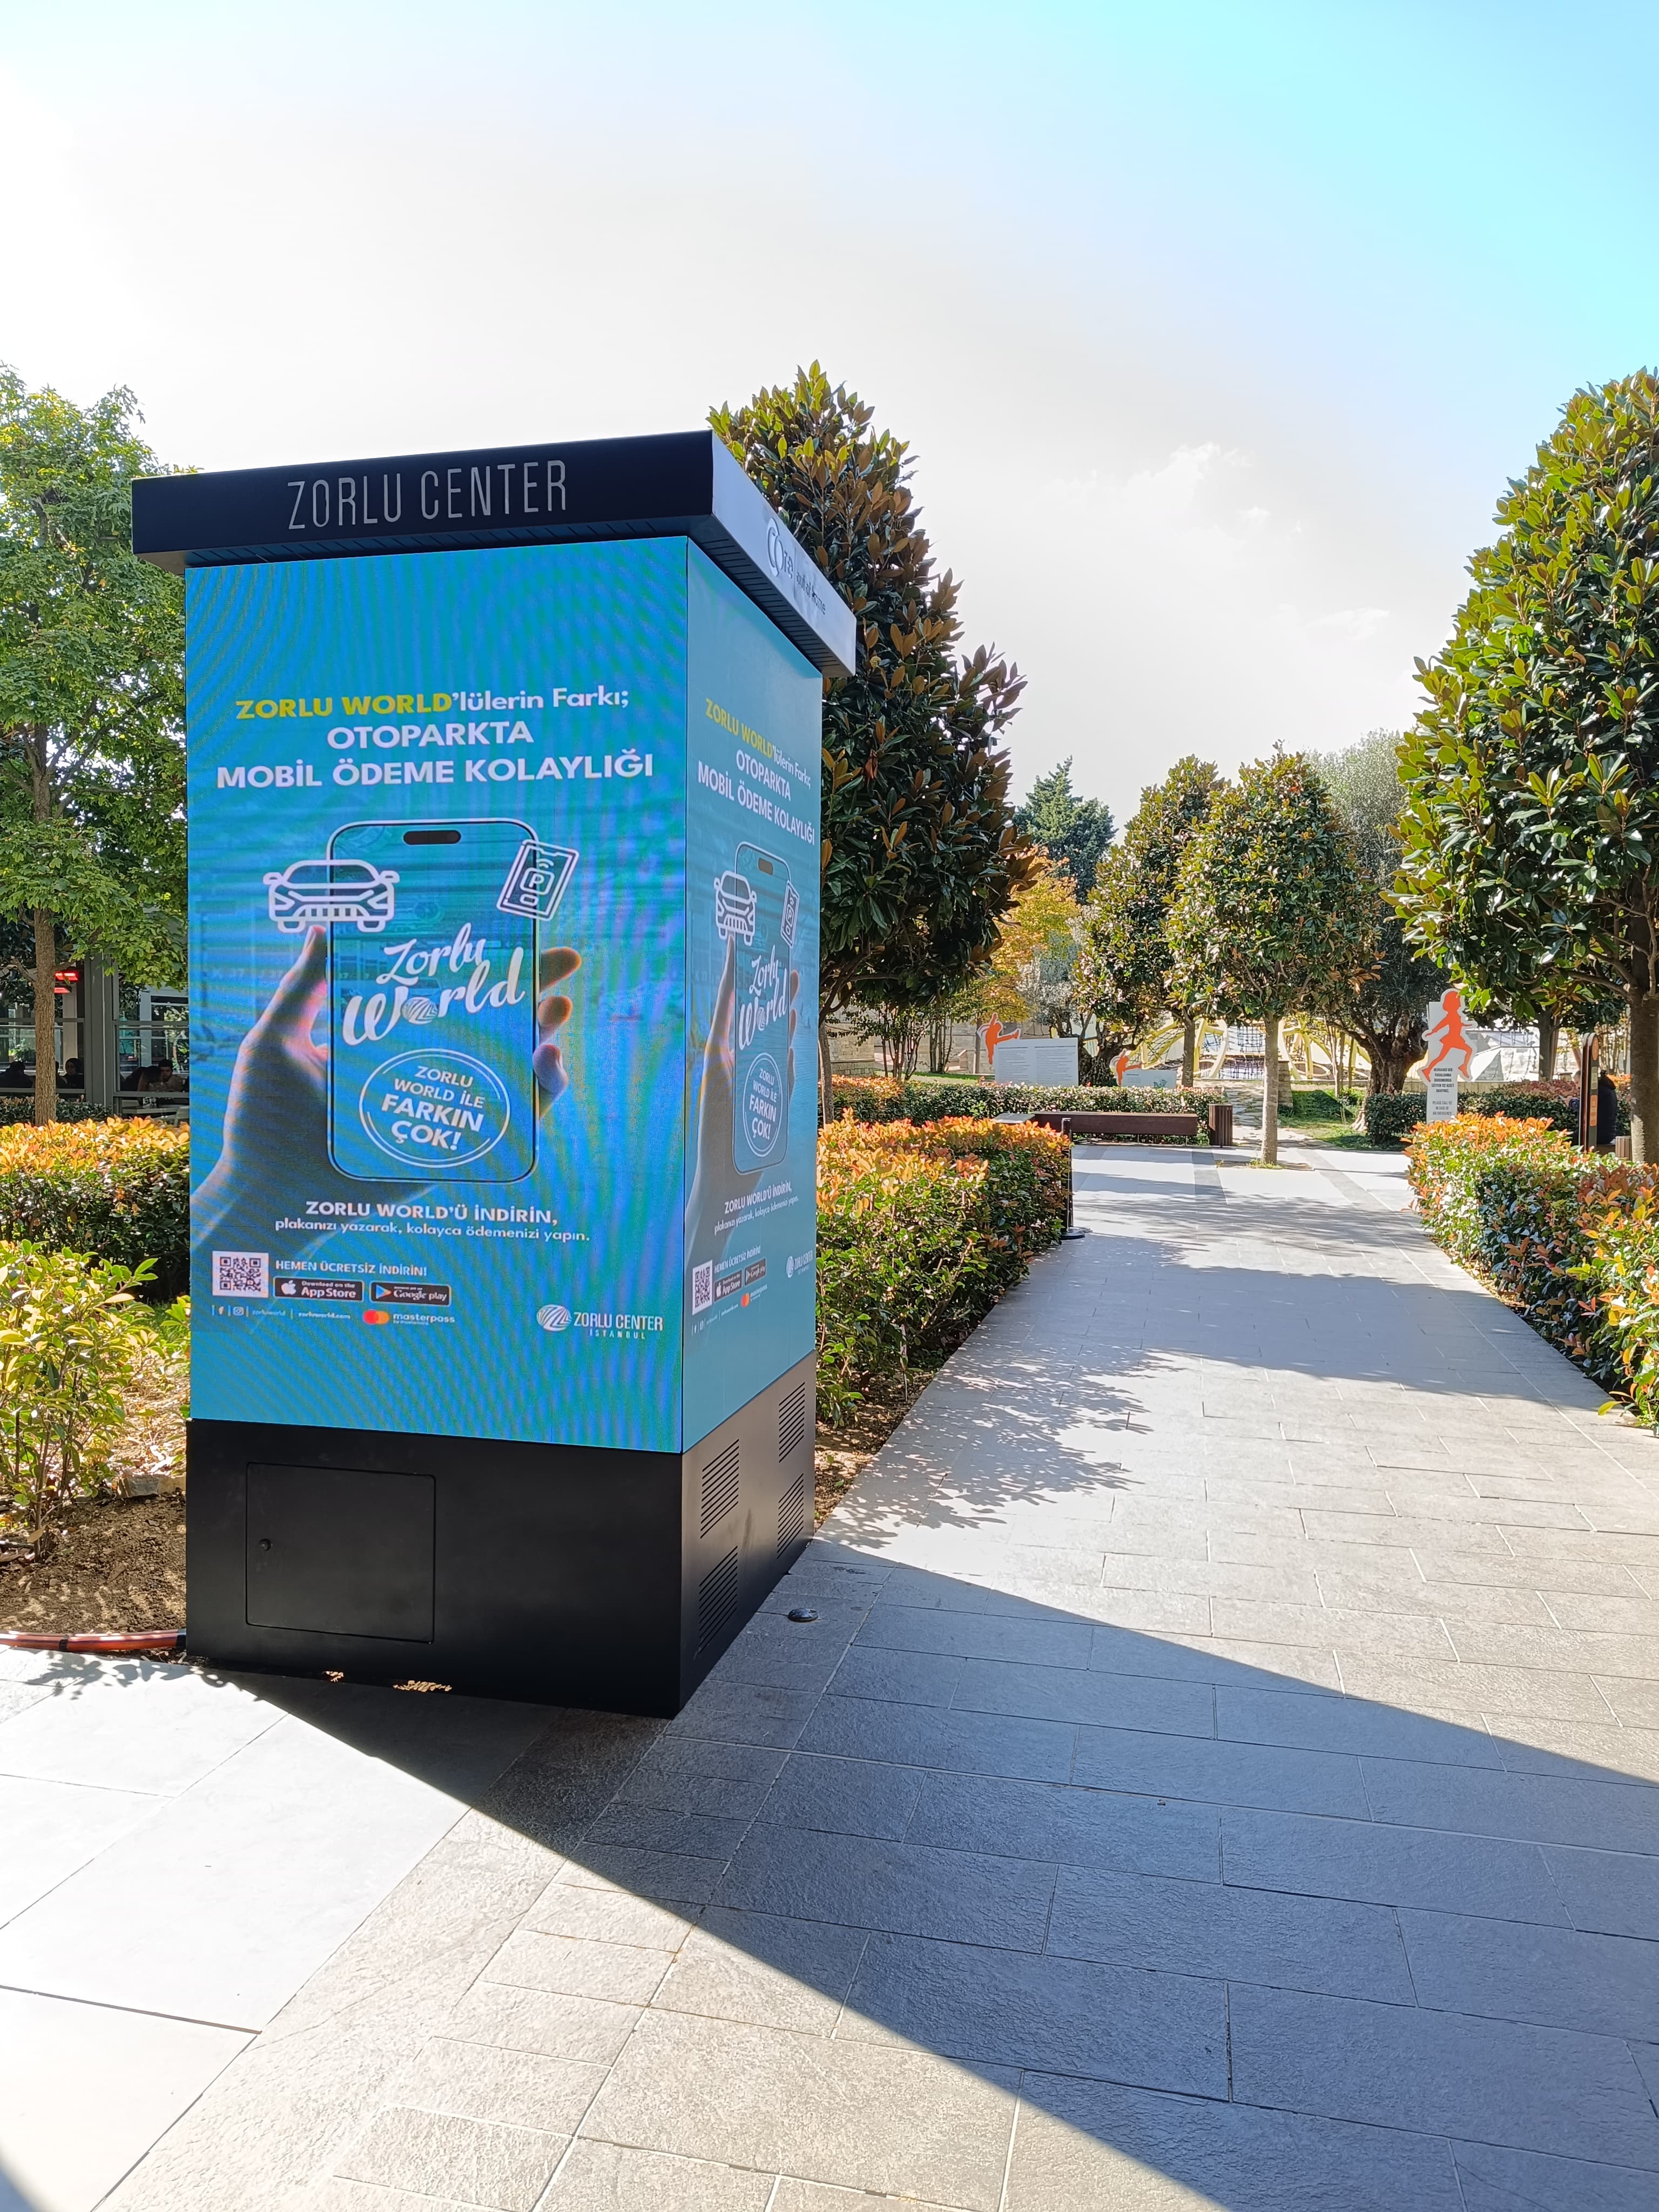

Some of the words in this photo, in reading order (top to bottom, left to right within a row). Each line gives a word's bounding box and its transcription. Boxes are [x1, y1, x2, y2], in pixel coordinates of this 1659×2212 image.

[287, 473, 401, 530] ZORLU
[420, 460, 567, 520] CENTER
[236, 697, 333, 719] ZORLU
[341, 690, 544, 716] WORLD'lülerin
[553, 685, 629, 708] Farkı;
[705, 697, 739, 736] ZORLU
[327, 720, 534, 750] OTOPARKTA
[217, 758, 323, 788] MOBİL
[333, 758, 454, 786] ÖDEME
[465, 747, 653, 783] KOLAYLIĞI
[736, 749, 791, 802] OTOPARKTA
[698, 760, 734, 801] MOBİL
[737, 779, 772, 821] ÖDEME
[774, 805, 815, 846] KOLAYLIĞI
[376, 922, 487, 985] Zorlu
[748, 944, 779, 996] Zorlu
[342, 947, 526, 1046] World
[738, 967, 787, 1050] World
[414, 1065, 474, 1088] ZORLU
[753, 1080, 770, 1098] WORLD
[759, 1067, 775, 1086] ZORLU
[394, 1078, 455, 1102] WORLD
[460, 1090, 485, 1109] İLE
[749, 1093, 777, 1123] FARKIN
[381, 1093, 484, 1132] FARKIN
[390, 1120, 462, 1151] ÇOK!
[752, 1117, 771, 1141] ÇOK!
[305, 1201, 371, 1216] ZORLU
[376, 1203, 468, 1220] WORLD'Ü
[474, 1204, 558, 1226] İNDİRİN,
[724, 1195, 746, 1215] ZORLU
[275, 1217, 337, 1231] plakanızı
[341, 1221, 402, 1235] yazarak,
[407, 1222, 462, 1238] kolayca
[466, 1225, 539, 1239] ödemenizi
[544, 1231, 590, 1243] yapın.
[275, 1260, 317, 1271] HEMEN
[320, 1260, 376, 1274] ÜCRETSİZ
[301, 1287, 325, 1298] App
[326, 1287, 357, 1298] Store
[393, 1289, 428, 1301] Google
[428, 1292, 447, 1302] play
[393, 1313, 456, 1323] masterpass
[573, 1311, 613, 1328] ZORLU
[615, 1313, 664, 1332] CENTER
